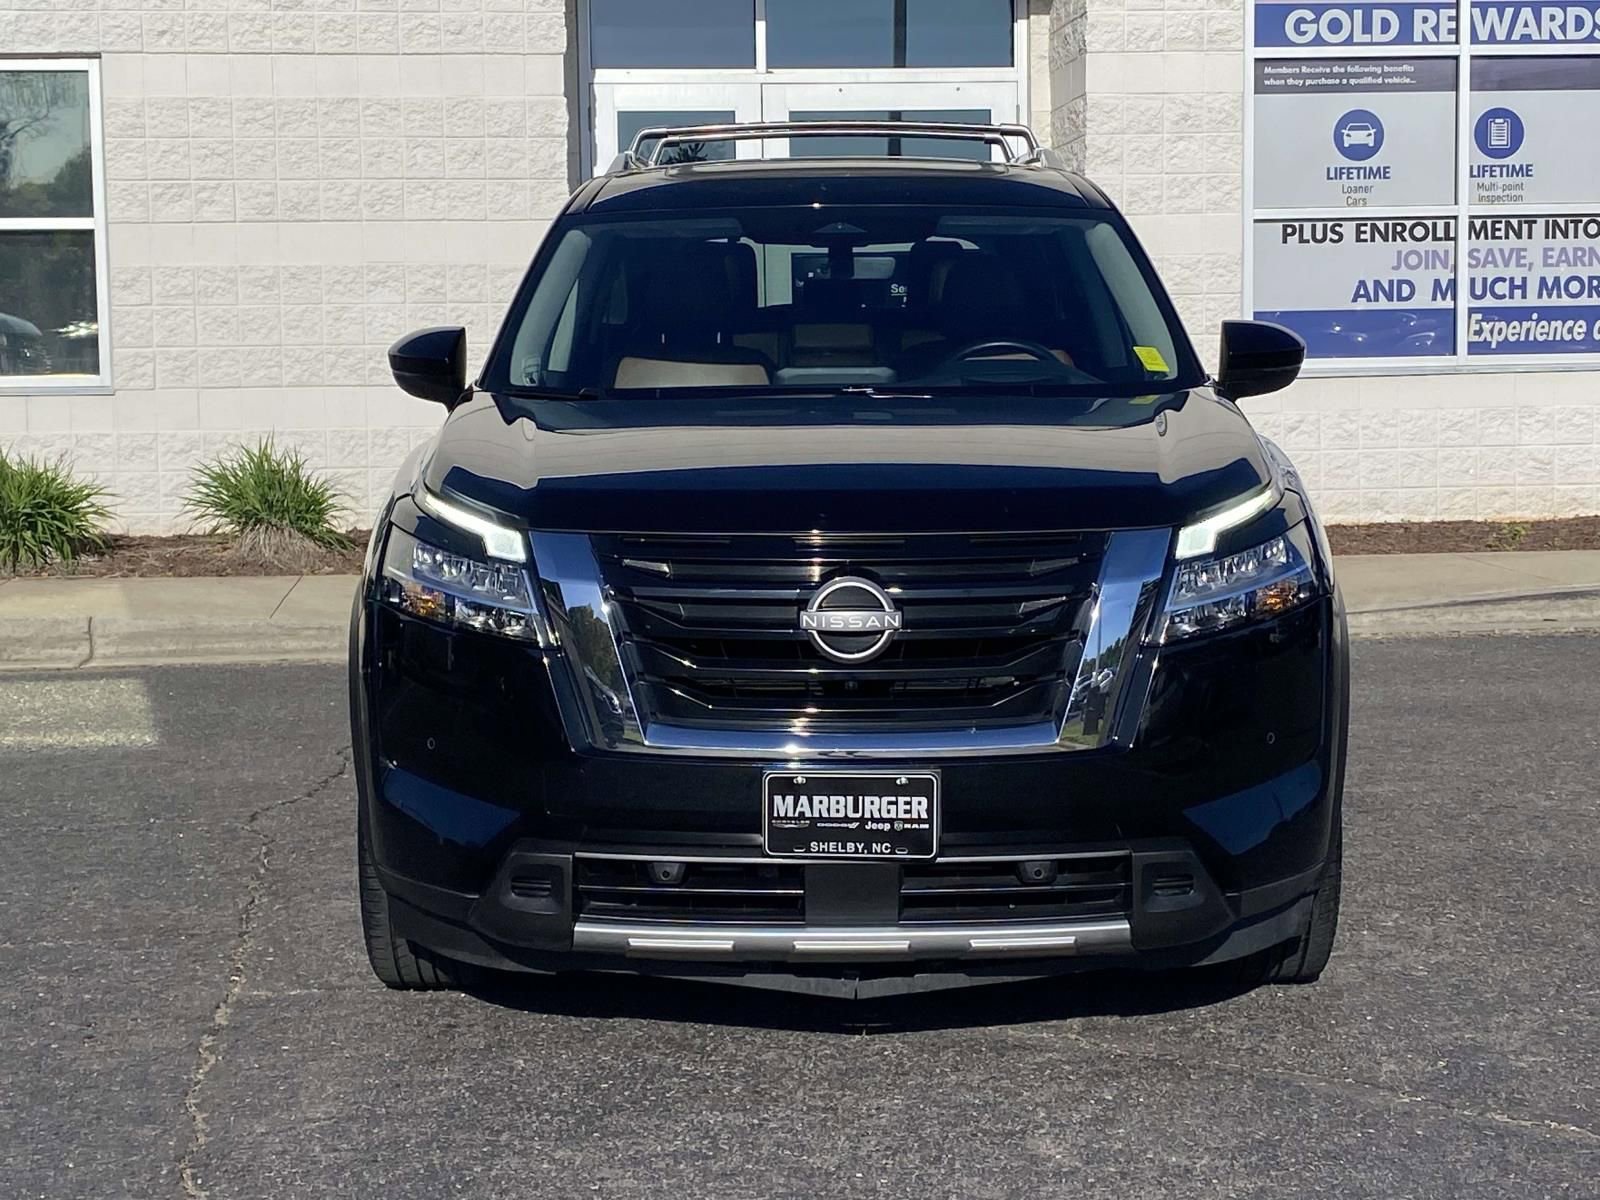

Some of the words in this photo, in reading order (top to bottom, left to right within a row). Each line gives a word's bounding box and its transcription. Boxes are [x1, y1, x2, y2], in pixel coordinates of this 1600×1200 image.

[1285, 8, 1399, 43] GOLD
[1264, 66, 1300, 74] Members
[1302, 65, 1331, 73] Receive
[1332, 65, 1345, 73] the
[1347, 64, 1382, 74] following
[1383, 64, 1415, 73] benefits
[1264, 77, 1285, 85] when
[1286, 77, 1304, 87] they
[1305, 77, 1340, 87] purchase
[1349, 76, 1383, 86] qualified
[1326, 166, 1391, 180] LIFETIME
[1469, 164, 1534, 178] LIFETIME
[1341, 184, 1373, 194] Loaner
[1477, 182, 1524, 194] Multi-point
[1346, 196, 1367, 207] Cars
[1478, 193, 1524, 205] Inspection
[1281, 222, 1344, 244] PLUS
[1544, 218, 1600, 239] INTO
[1391, 249, 1455, 273] JOIN,
[1467, 247, 1534, 272] SAVE,
[1542, 246, 1600, 267] EARN
[1351, 278, 1415, 303] AND
[1468, 313, 1586, 348] Experience
[802, 615, 899, 628] NISSAN
[773, 795, 929, 819] MARBURGER
[864, 821, 891, 831] Jeep
[810, 841, 867, 854] SHELBY,
[872, 842, 892, 854] NC
